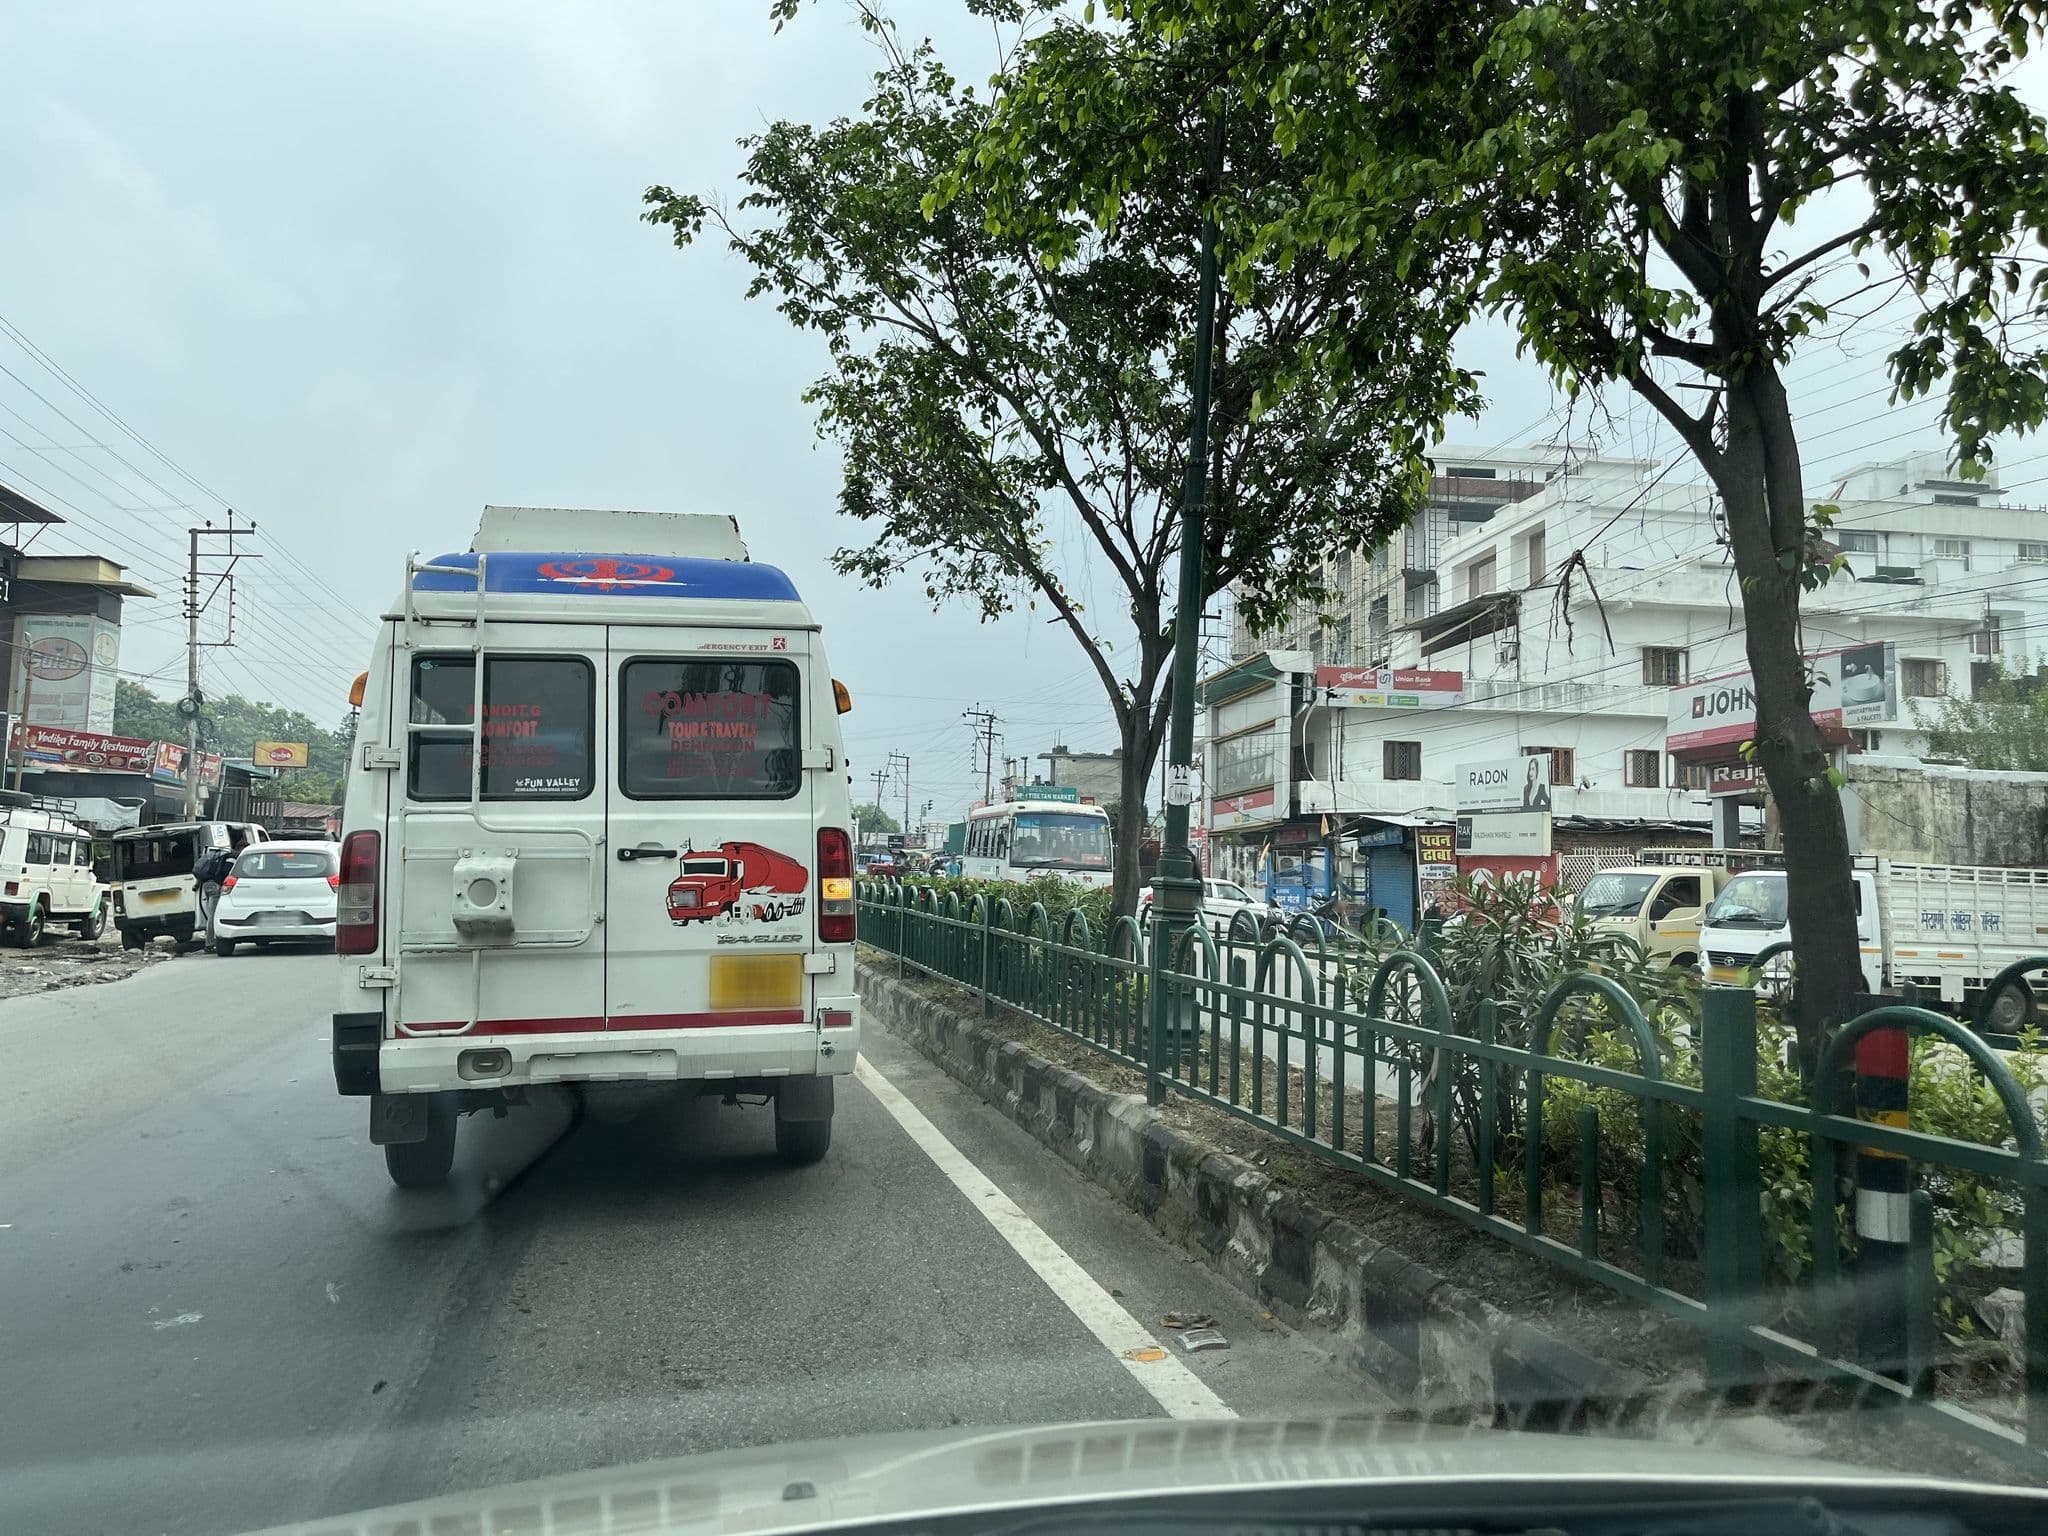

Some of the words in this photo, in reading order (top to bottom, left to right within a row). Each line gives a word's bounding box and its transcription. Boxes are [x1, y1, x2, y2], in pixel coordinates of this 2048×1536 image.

[642, 690, 773, 720] COMFORT
[1861, 713, 1881, 721] FAUCETS
[481, 720, 538, 737] OMFORT
[667, 721, 699, 737] TOUR
[37, 730, 66, 747] Vedika
[68, 735, 100, 751] Family
[100, 739, 150, 757] Restaurant
[1174, 765, 1188, 780] 22
[1469, 768, 1508, 786] RADON
[524, 778, 543, 788] FUN
[546, 777, 580, 787] VALLEY
[1457, 825, 1471, 835] RAK
[1420, 835, 1452, 847] पवन
[1421, 849, 1452, 861] ढाबा
[717, 934, 803, 945] TRAVELLER
